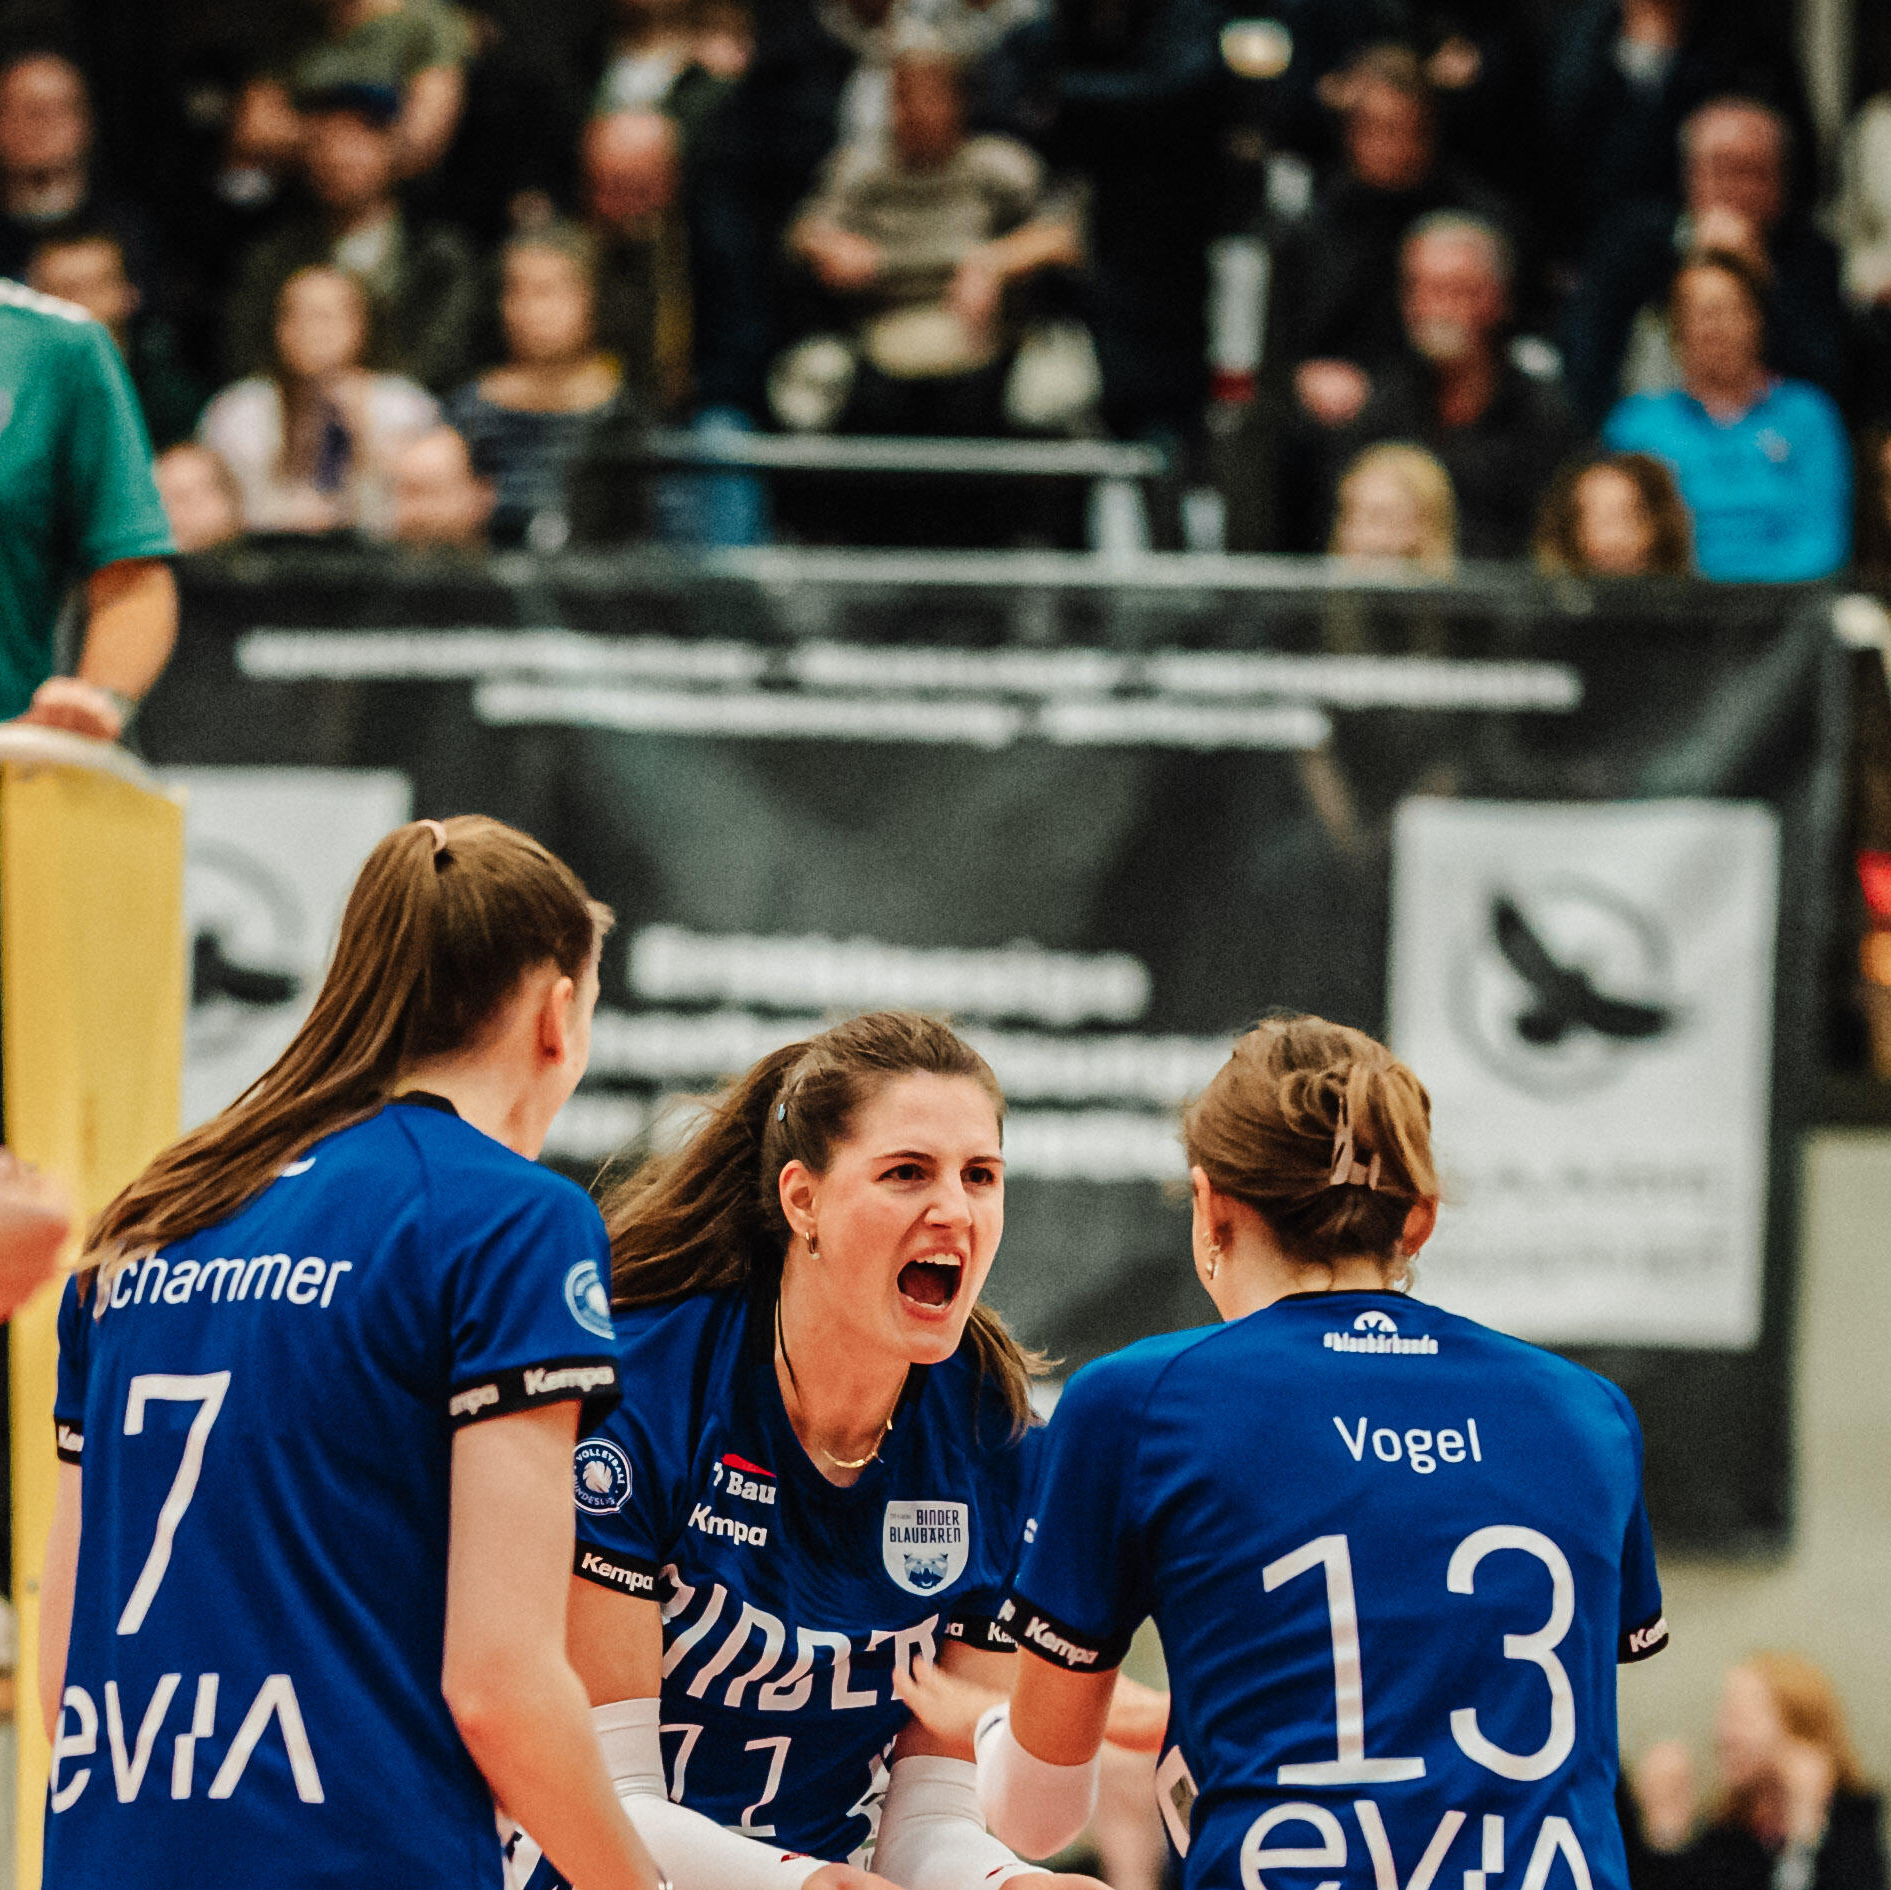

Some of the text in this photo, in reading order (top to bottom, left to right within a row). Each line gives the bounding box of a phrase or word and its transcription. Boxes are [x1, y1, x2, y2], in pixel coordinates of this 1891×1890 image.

[523, 1366, 615, 1395] Kempa
[1333, 1416, 1482, 1474] Vogel
[576, 1448, 626, 1484] VOLLEYBALL
[116, 1370, 231, 1635] 7
[726, 1471, 776, 1505] Bau
[688, 1503, 767, 1546] Kmpa
[890, 1526, 961, 1543] BLAUBÄREN
[916, 1509, 960, 1526] BINDER
[581, 1553, 654, 1591] Kempa
[1024, 1616, 1099, 1666] Kempa
[1262, 1525, 1577, 1785] 13
